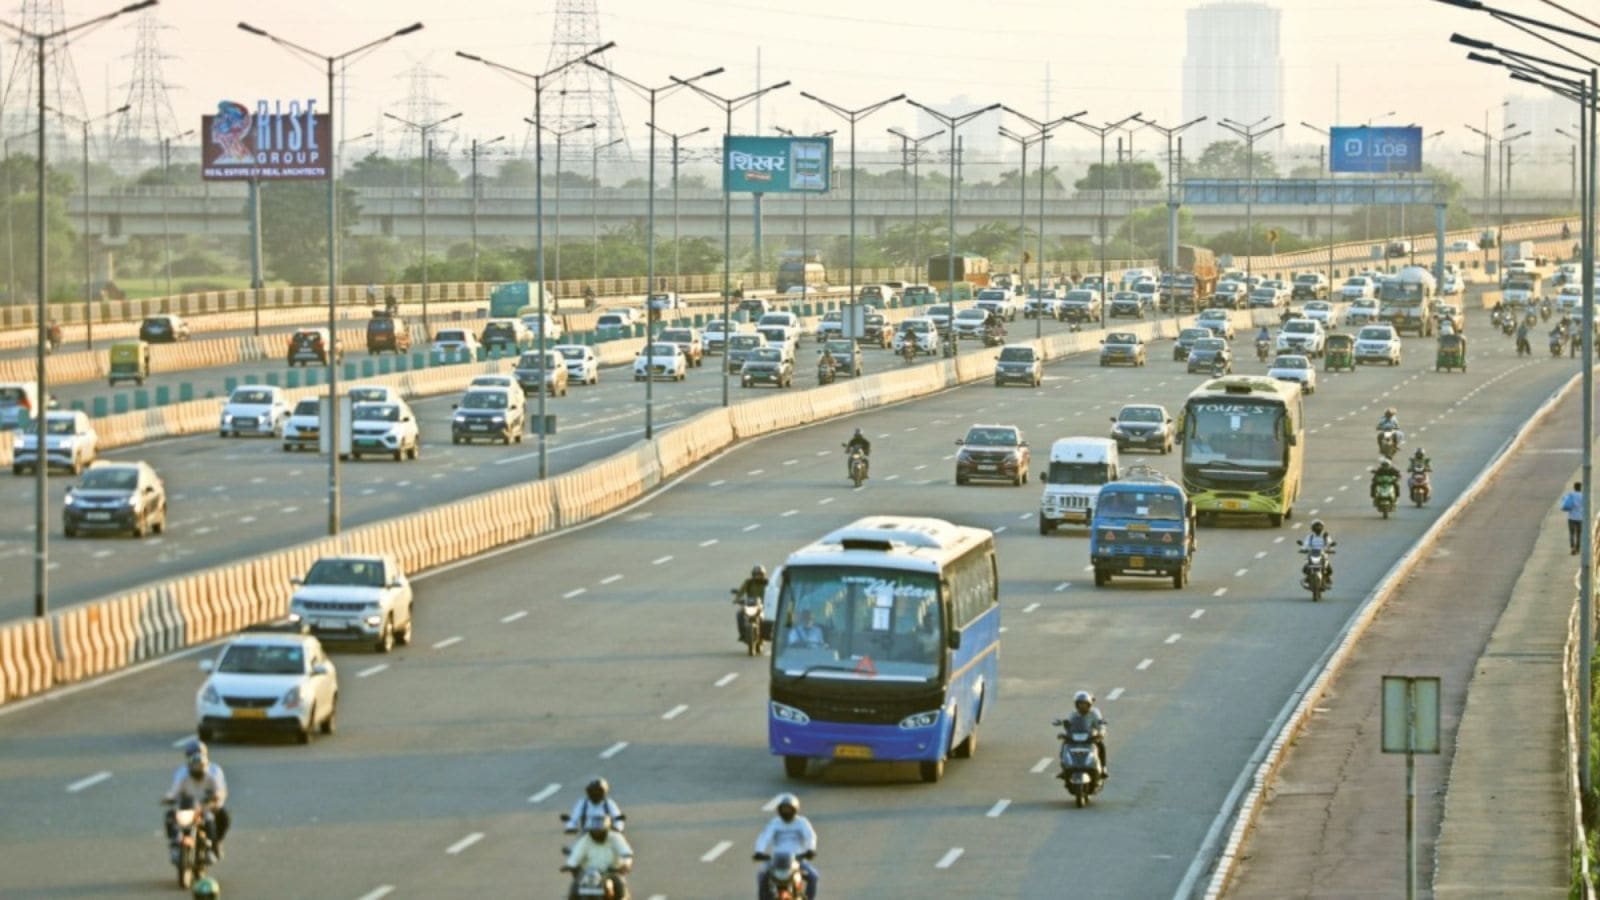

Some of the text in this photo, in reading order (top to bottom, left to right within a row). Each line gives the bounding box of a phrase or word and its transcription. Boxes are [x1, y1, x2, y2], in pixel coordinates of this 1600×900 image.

[257, 99, 319, 151] RISE
[1373, 143, 1408, 157] 108
[257, 152, 319, 164] GROUP
